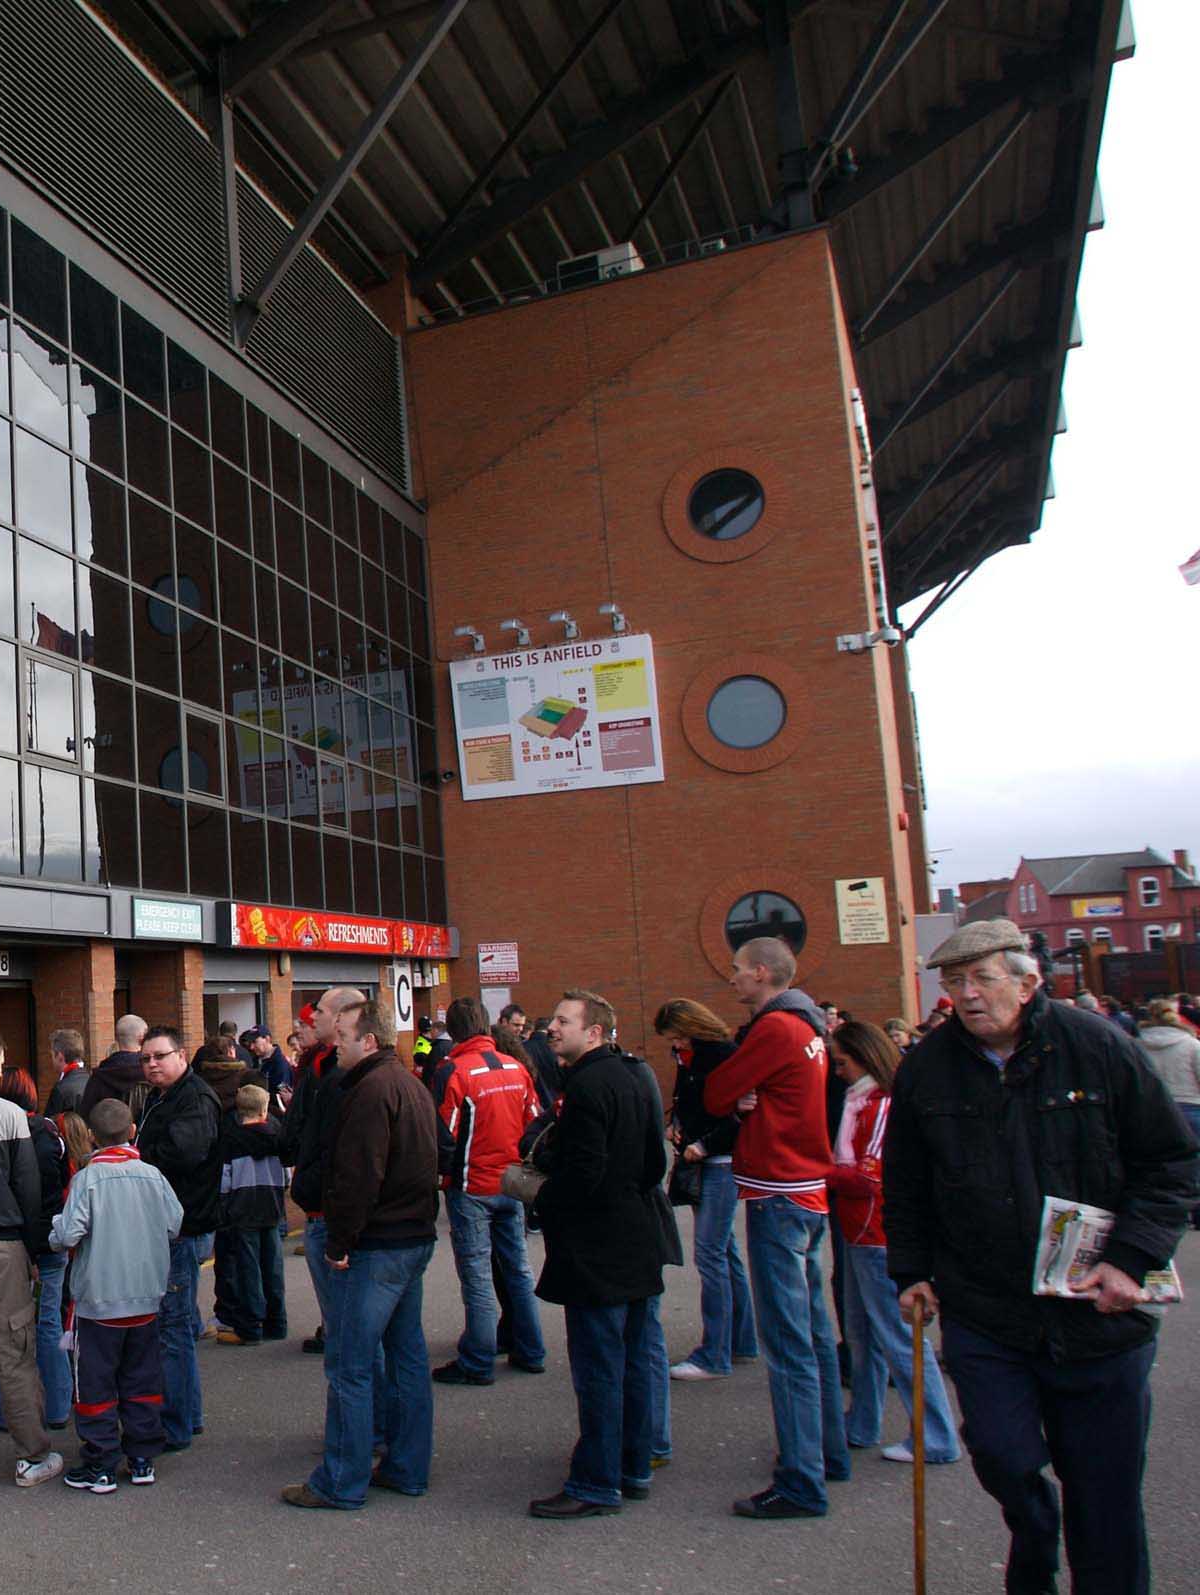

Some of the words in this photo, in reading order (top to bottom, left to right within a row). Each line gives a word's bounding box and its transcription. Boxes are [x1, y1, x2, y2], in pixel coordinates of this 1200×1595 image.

[492, 655, 522, 670] THIS
[526, 652, 539, 666] IS
[544, 643, 602, 663] ANFIELD
[328, 922, 388, 945] REFRESHMENTS
[397, 974, 411, 1022] C
